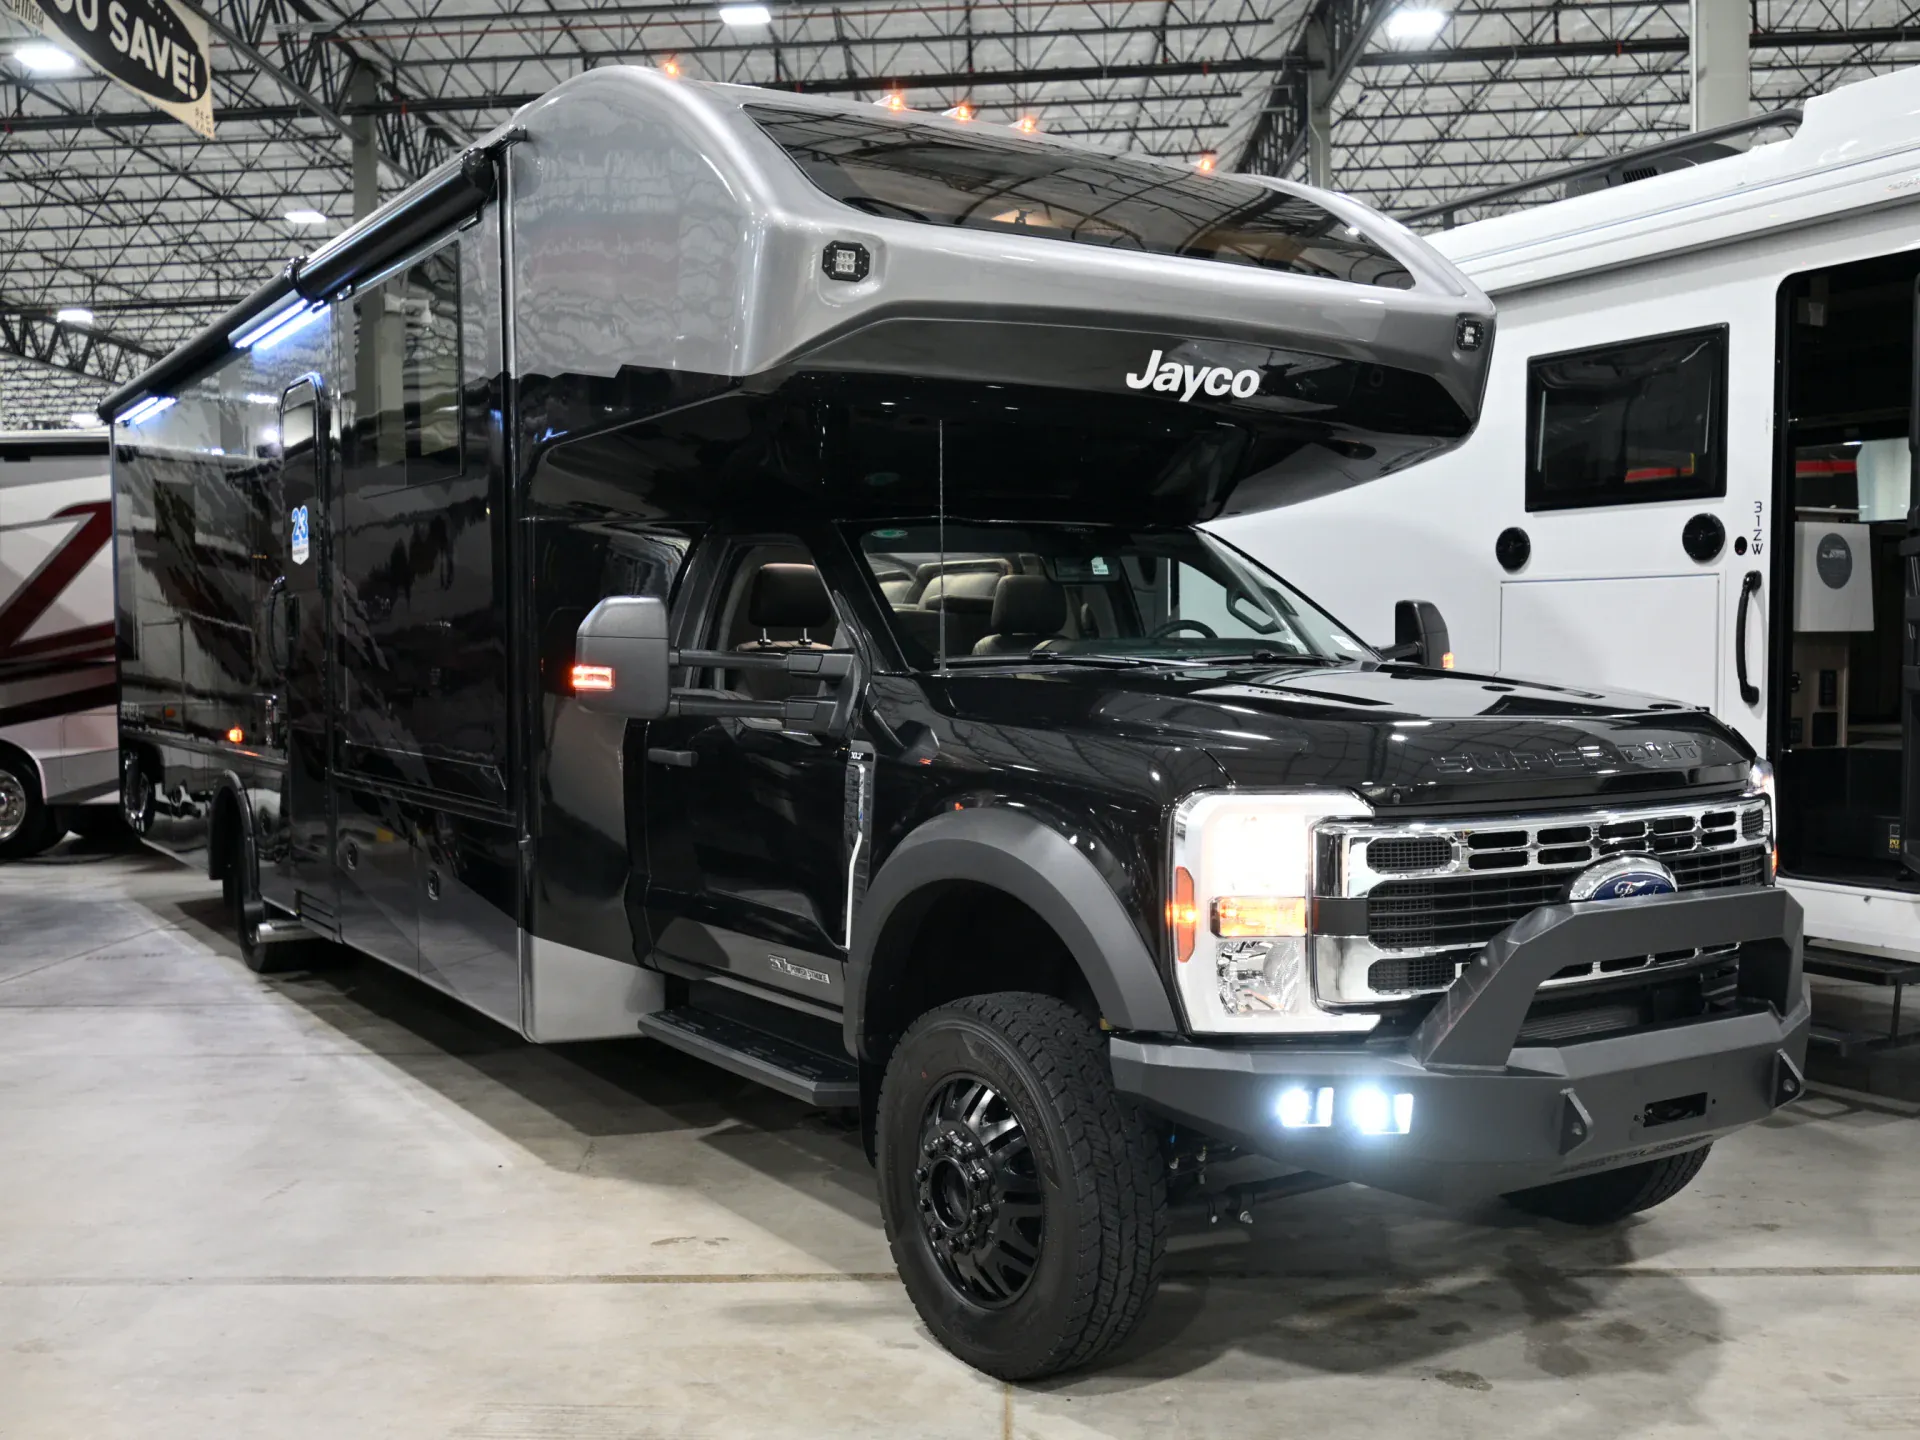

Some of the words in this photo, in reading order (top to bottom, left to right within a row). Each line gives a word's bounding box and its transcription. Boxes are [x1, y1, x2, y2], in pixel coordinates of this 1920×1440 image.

[108, 1, 197, 100] SAVE!
[1126, 350, 1260, 402] Jayco
[292, 506, 308, 541] 23
[1430, 745, 1617, 774] SUPER
